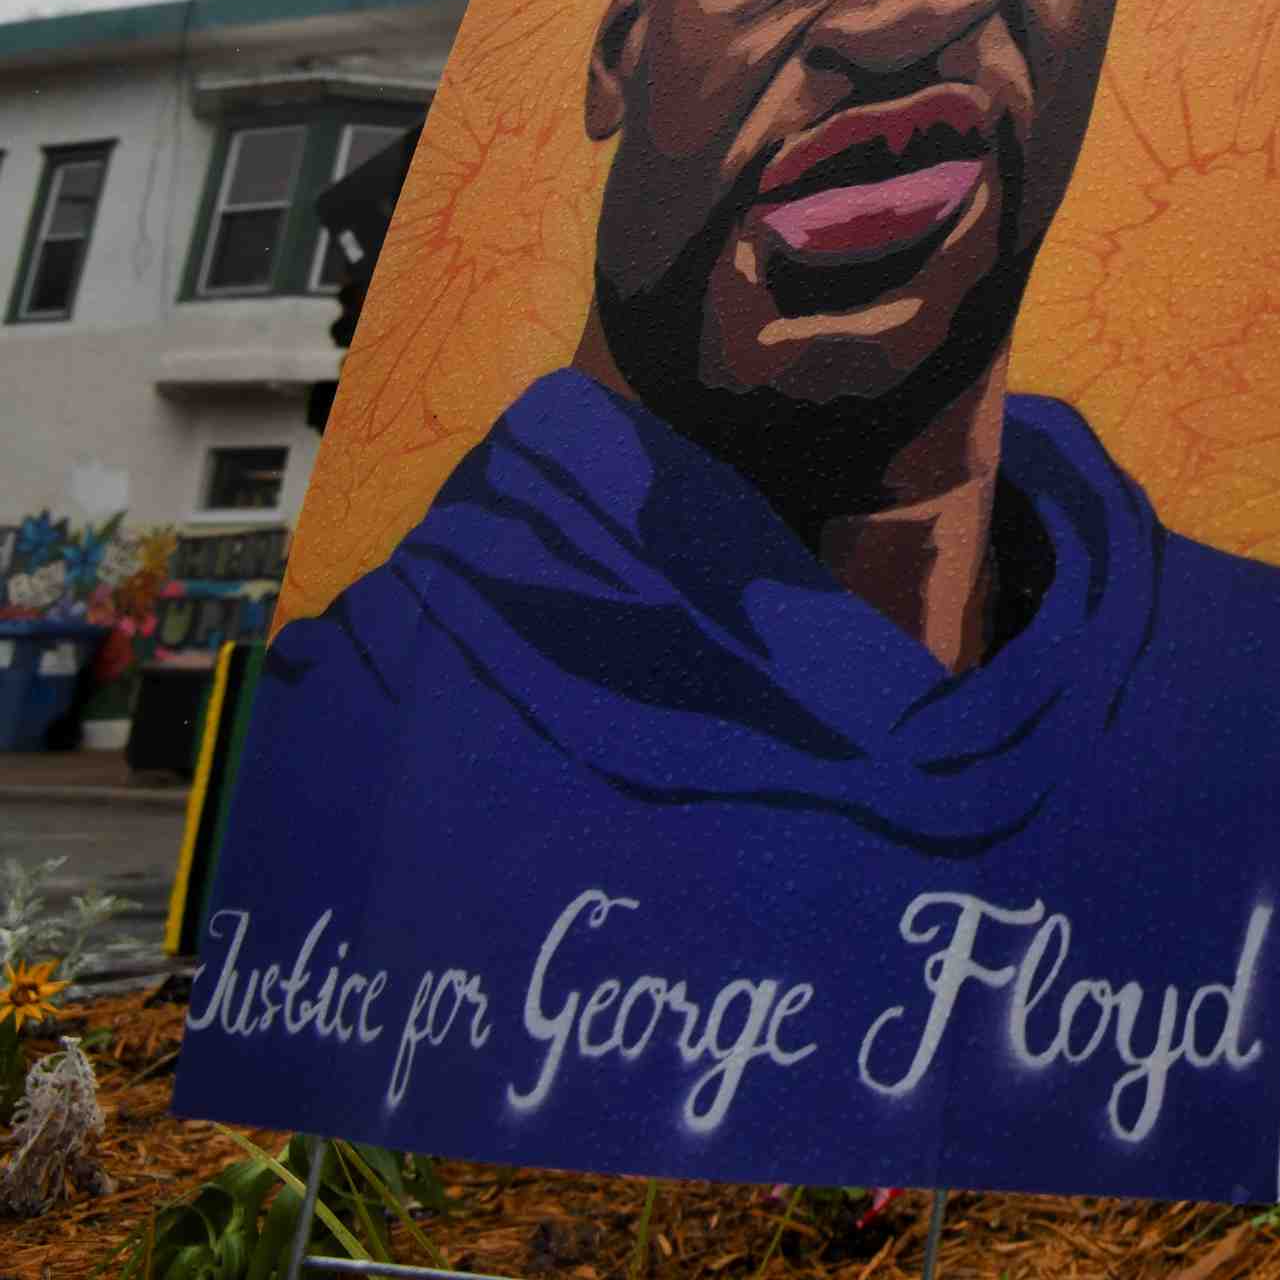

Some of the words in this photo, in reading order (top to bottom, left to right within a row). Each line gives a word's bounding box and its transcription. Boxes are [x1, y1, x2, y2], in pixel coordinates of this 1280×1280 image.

[187, 909, 388, 1044] Justice
[386, 966, 491, 1108] for
[507, 889, 817, 1133] George
[858, 891, 1274, 1142] Floyd
